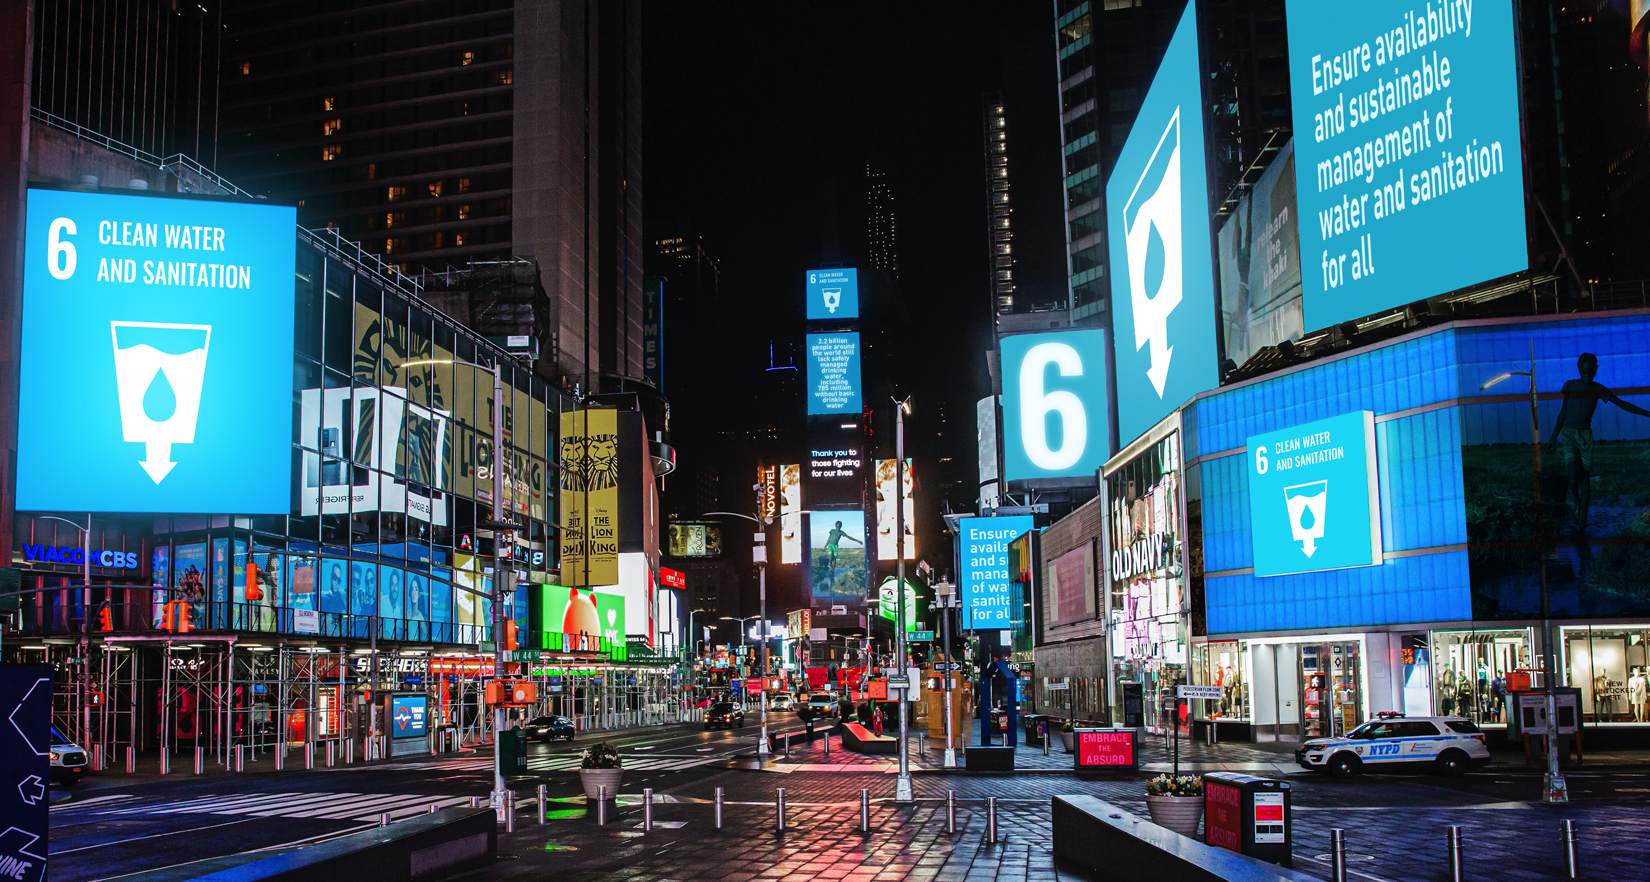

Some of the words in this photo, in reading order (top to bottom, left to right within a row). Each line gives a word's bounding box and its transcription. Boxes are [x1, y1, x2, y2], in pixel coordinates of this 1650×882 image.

[1311, 42, 1370, 96] Ensure
[1376, 0, 1472, 66] availability
[1314, 93, 1344, 142] and
[1350, 50, 1450, 128] sustainable
[1317, 110, 1431, 192] management
[1436, 96, 1452, 142] of
[1319, 192, 1369, 240] water
[1374, 169, 1405, 220] and
[1410, 139, 1504, 205] sanitation
[98, 220, 157, 248] CLEAN
[164, 224, 225, 251] WATER
[47, 217, 77, 280] 6
[1266, 238, 1280, 264] the
[97, 258, 136, 283] AND
[143, 260, 250, 289] SANITATION
[1264, 250, 1287, 290] khaki
[1322, 249, 1346, 291] for
[1352, 233, 1374, 280] all
[810, 274, 816, 284] 6
[644, 292, 658, 369] TIMES
[1020, 342, 1087, 470] 6
[1275, 438, 1300, 454] CLEAN
[1302, 431, 1330, 448] WATER
[833, 459, 860, 468] fighting
[1256, 446, 1268, 474] 6
[1276, 458, 1293, 471] AND
[1294, 446, 1344, 468] SANITATION
[766, 466, 775, 517] NOVOTEL
[591, 526, 612, 539] LION
[695, 527, 703, 555] FROZEN
[970, 528, 1017, 540] Ensure
[23, 543, 137, 569] VIACOMCBS
[590, 540, 616, 555] KING
[1112, 546, 1132, 581] OLD
[1133, 532, 1164, 575] NAVY
[971, 555, 994, 567] and
[999, 556, 1008, 566] s
[972, 582, 985, 593] of
[988, 583, 1009, 593] wa
[973, 608, 992, 620] for
[605, 629, 619, 644] NYC
[1083, 734, 1128, 743] EMBRACE
[1370, 744, 1400, 755] NYPD
[1086, 755, 1125, 765] ABSURD
[1207, 784, 1238, 807] EMBRACE
[1218, 808, 1227, 822] THE
[1210, 825, 1236, 850] ABSURD
